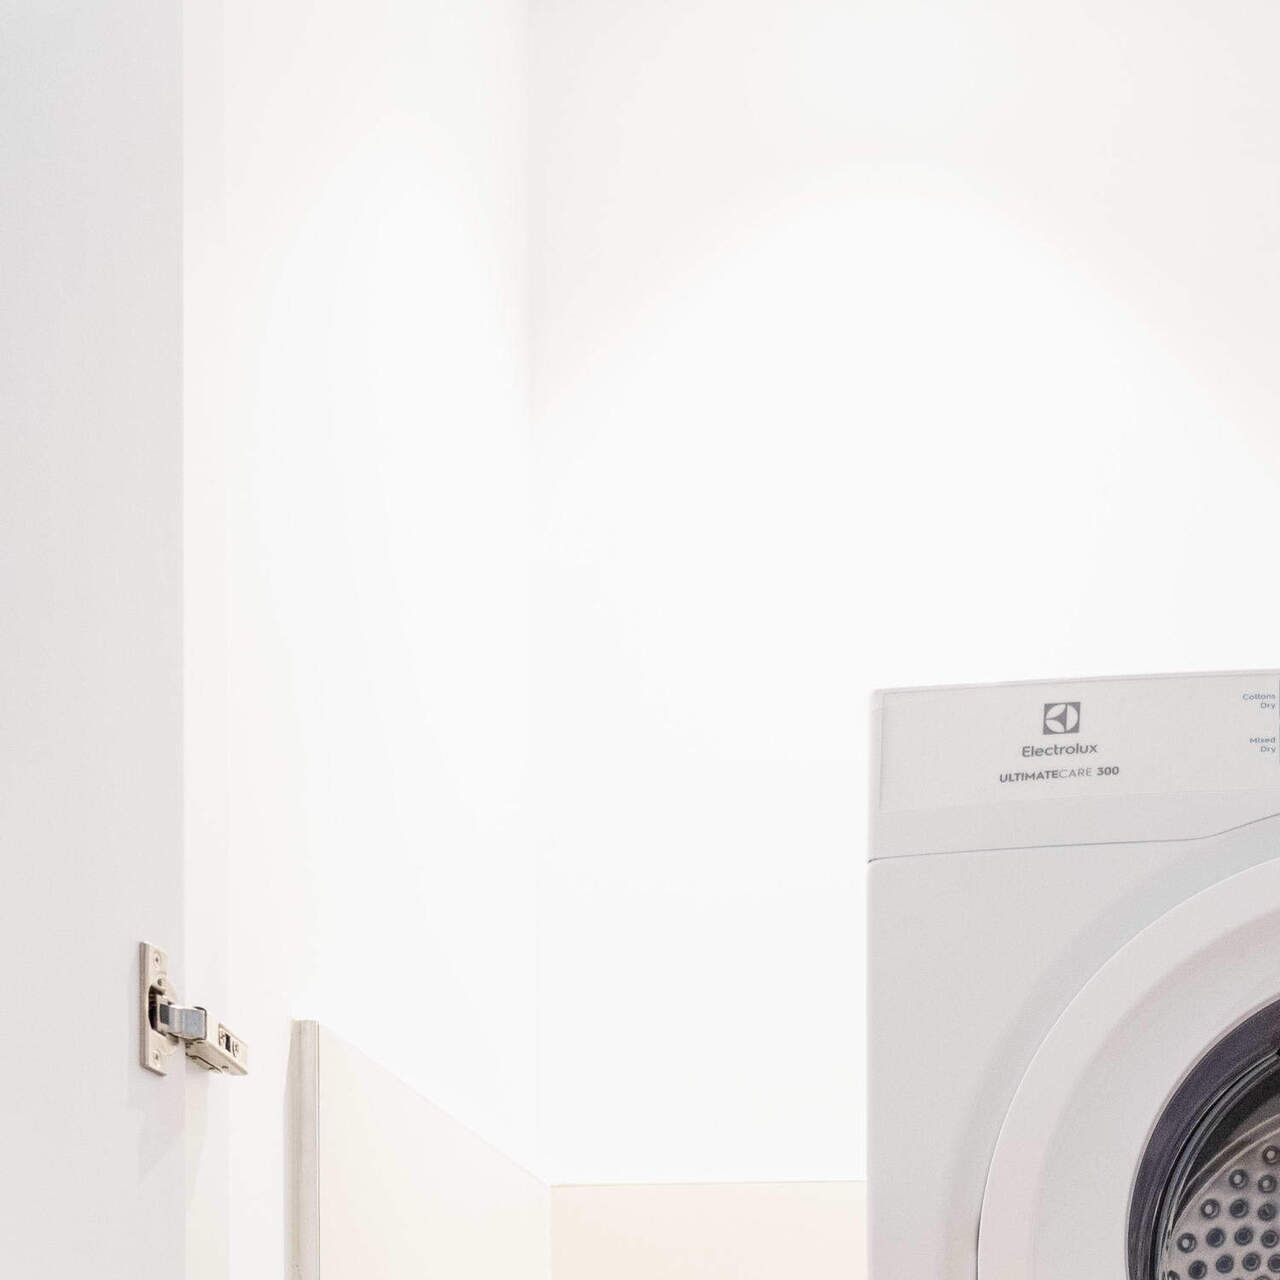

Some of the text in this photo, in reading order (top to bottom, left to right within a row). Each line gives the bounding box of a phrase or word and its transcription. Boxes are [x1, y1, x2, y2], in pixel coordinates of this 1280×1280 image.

[1242, 693, 1276, 701] Cottons
[1249, 736, 1276, 744] Mixed
[1022, 743, 1098, 758] Electrolux
[999, 766, 1120, 783] ULTIMATECARE 300
